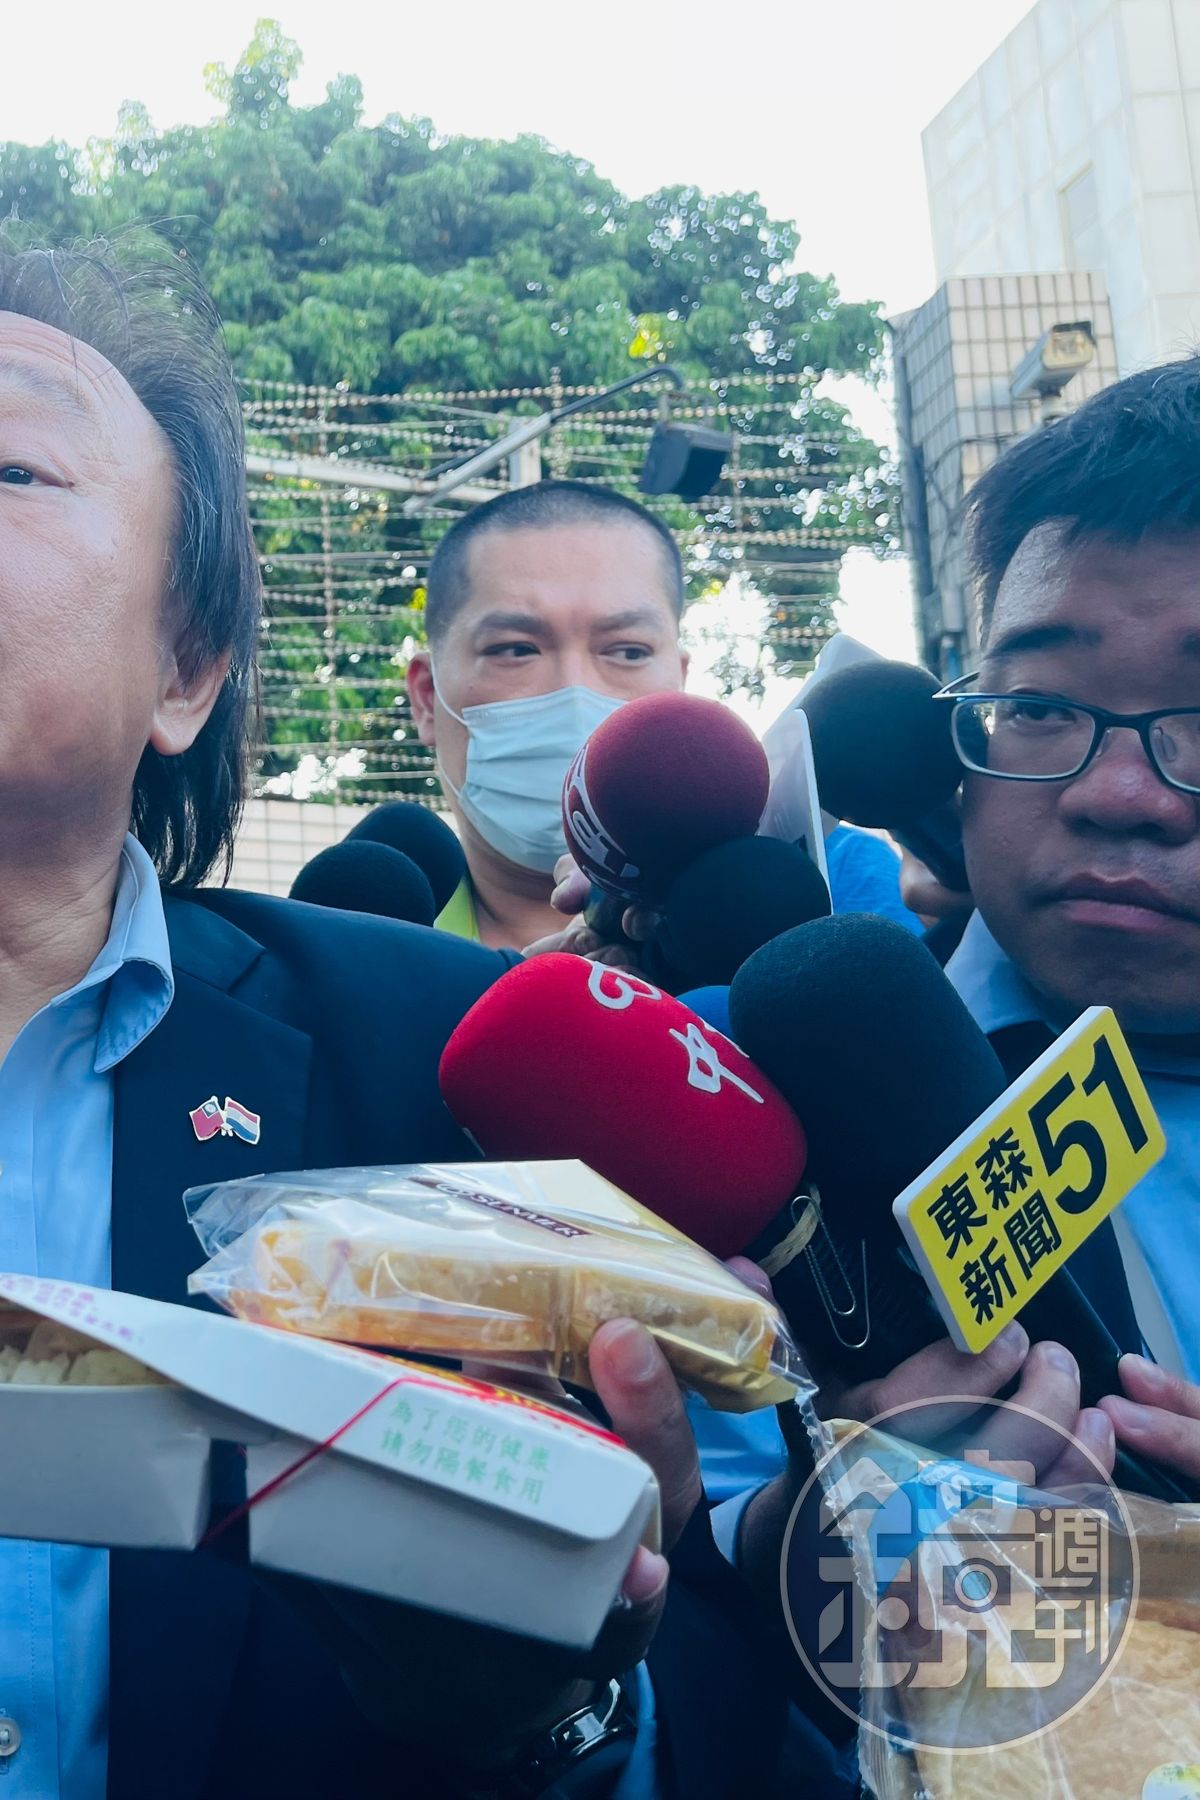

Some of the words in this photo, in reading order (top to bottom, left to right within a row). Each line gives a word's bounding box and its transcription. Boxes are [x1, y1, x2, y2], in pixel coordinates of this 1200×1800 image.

[926, 1127, 1033, 1260] 東森
[1027, 1033, 1149, 1215] 51
[959, 1189, 1062, 1325] 新聞
[389, 1400, 550, 1473] 為了您的健康
